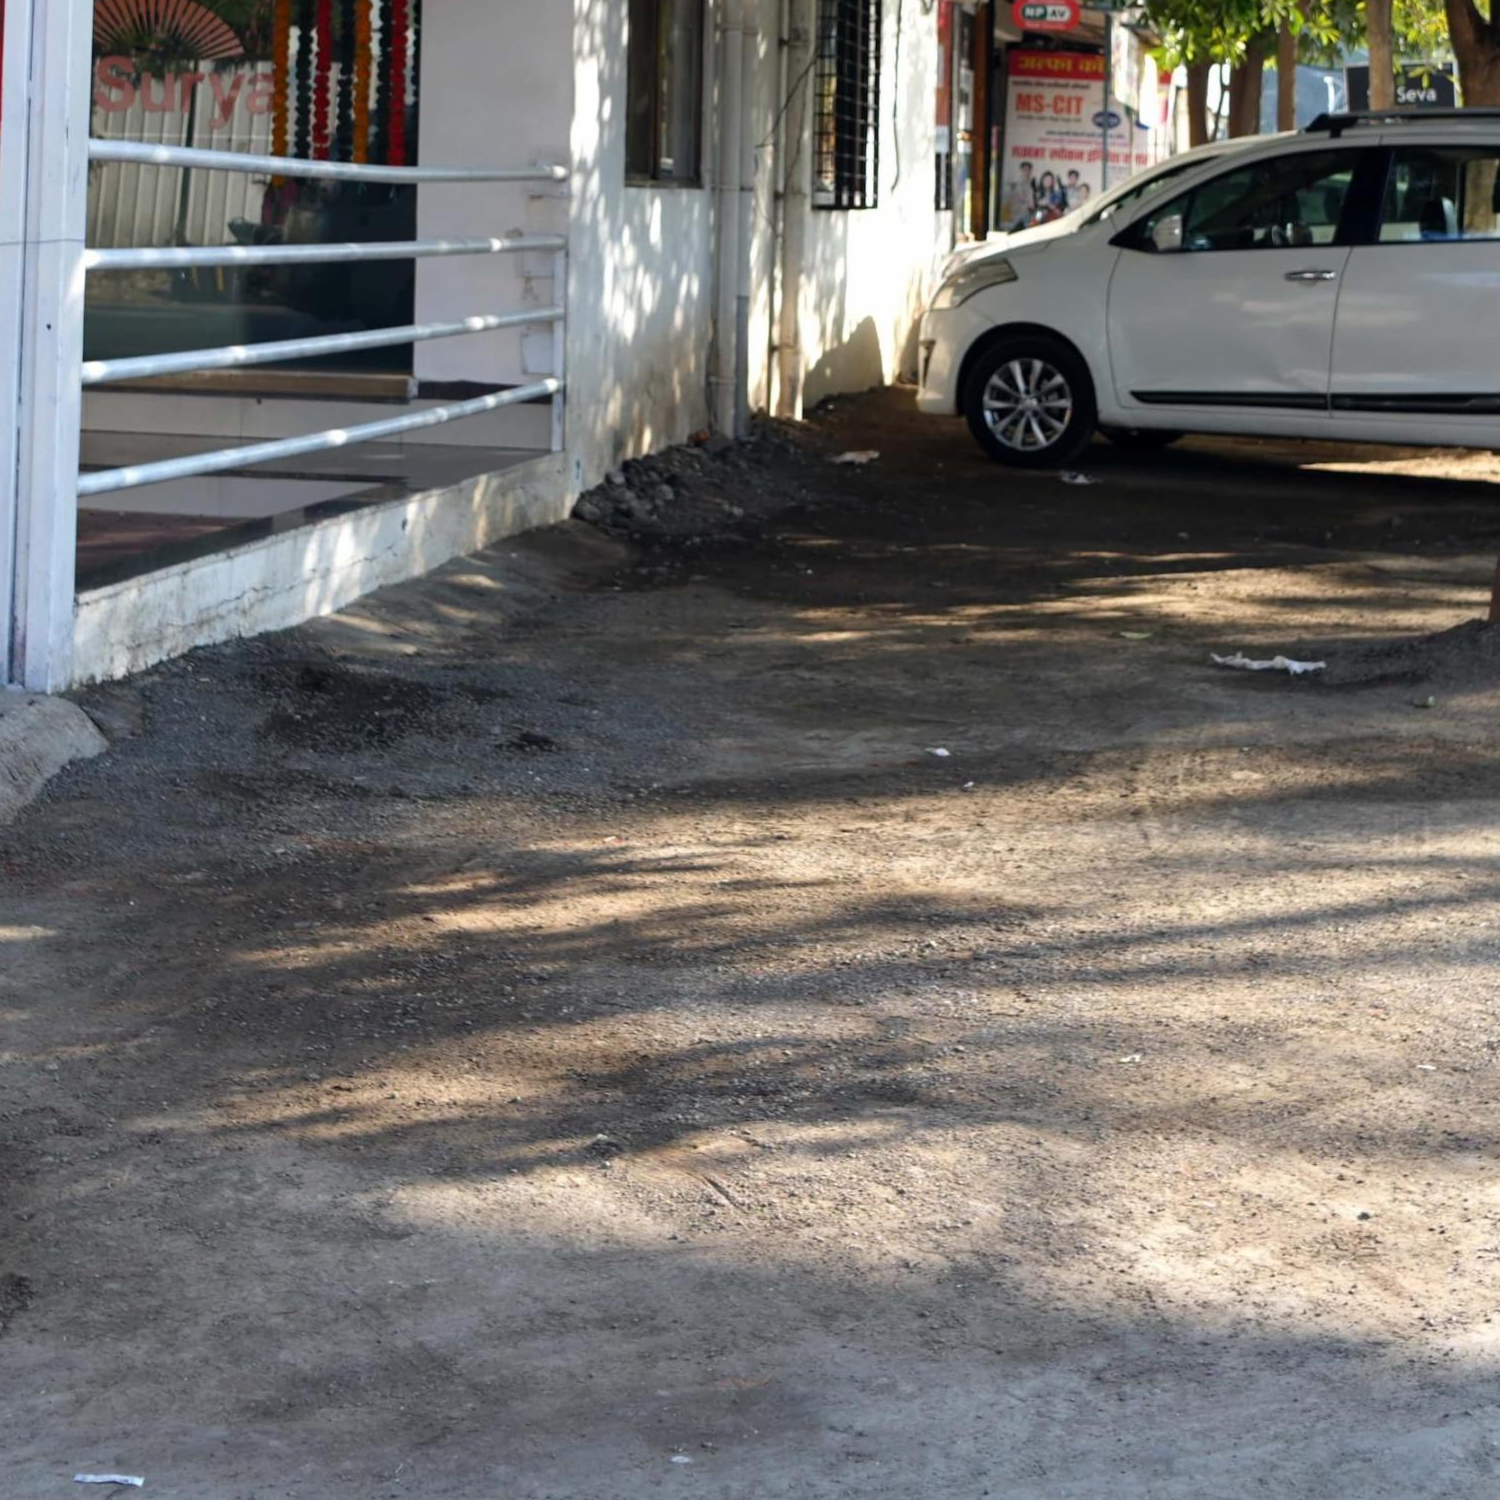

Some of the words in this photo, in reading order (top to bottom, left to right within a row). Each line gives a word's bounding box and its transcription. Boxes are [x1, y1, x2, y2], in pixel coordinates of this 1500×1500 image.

[94, 55, 276, 131] Surya
[1014, 91, 1084, 116] MS-CIT
[1396, 86, 1437, 103] Seva
